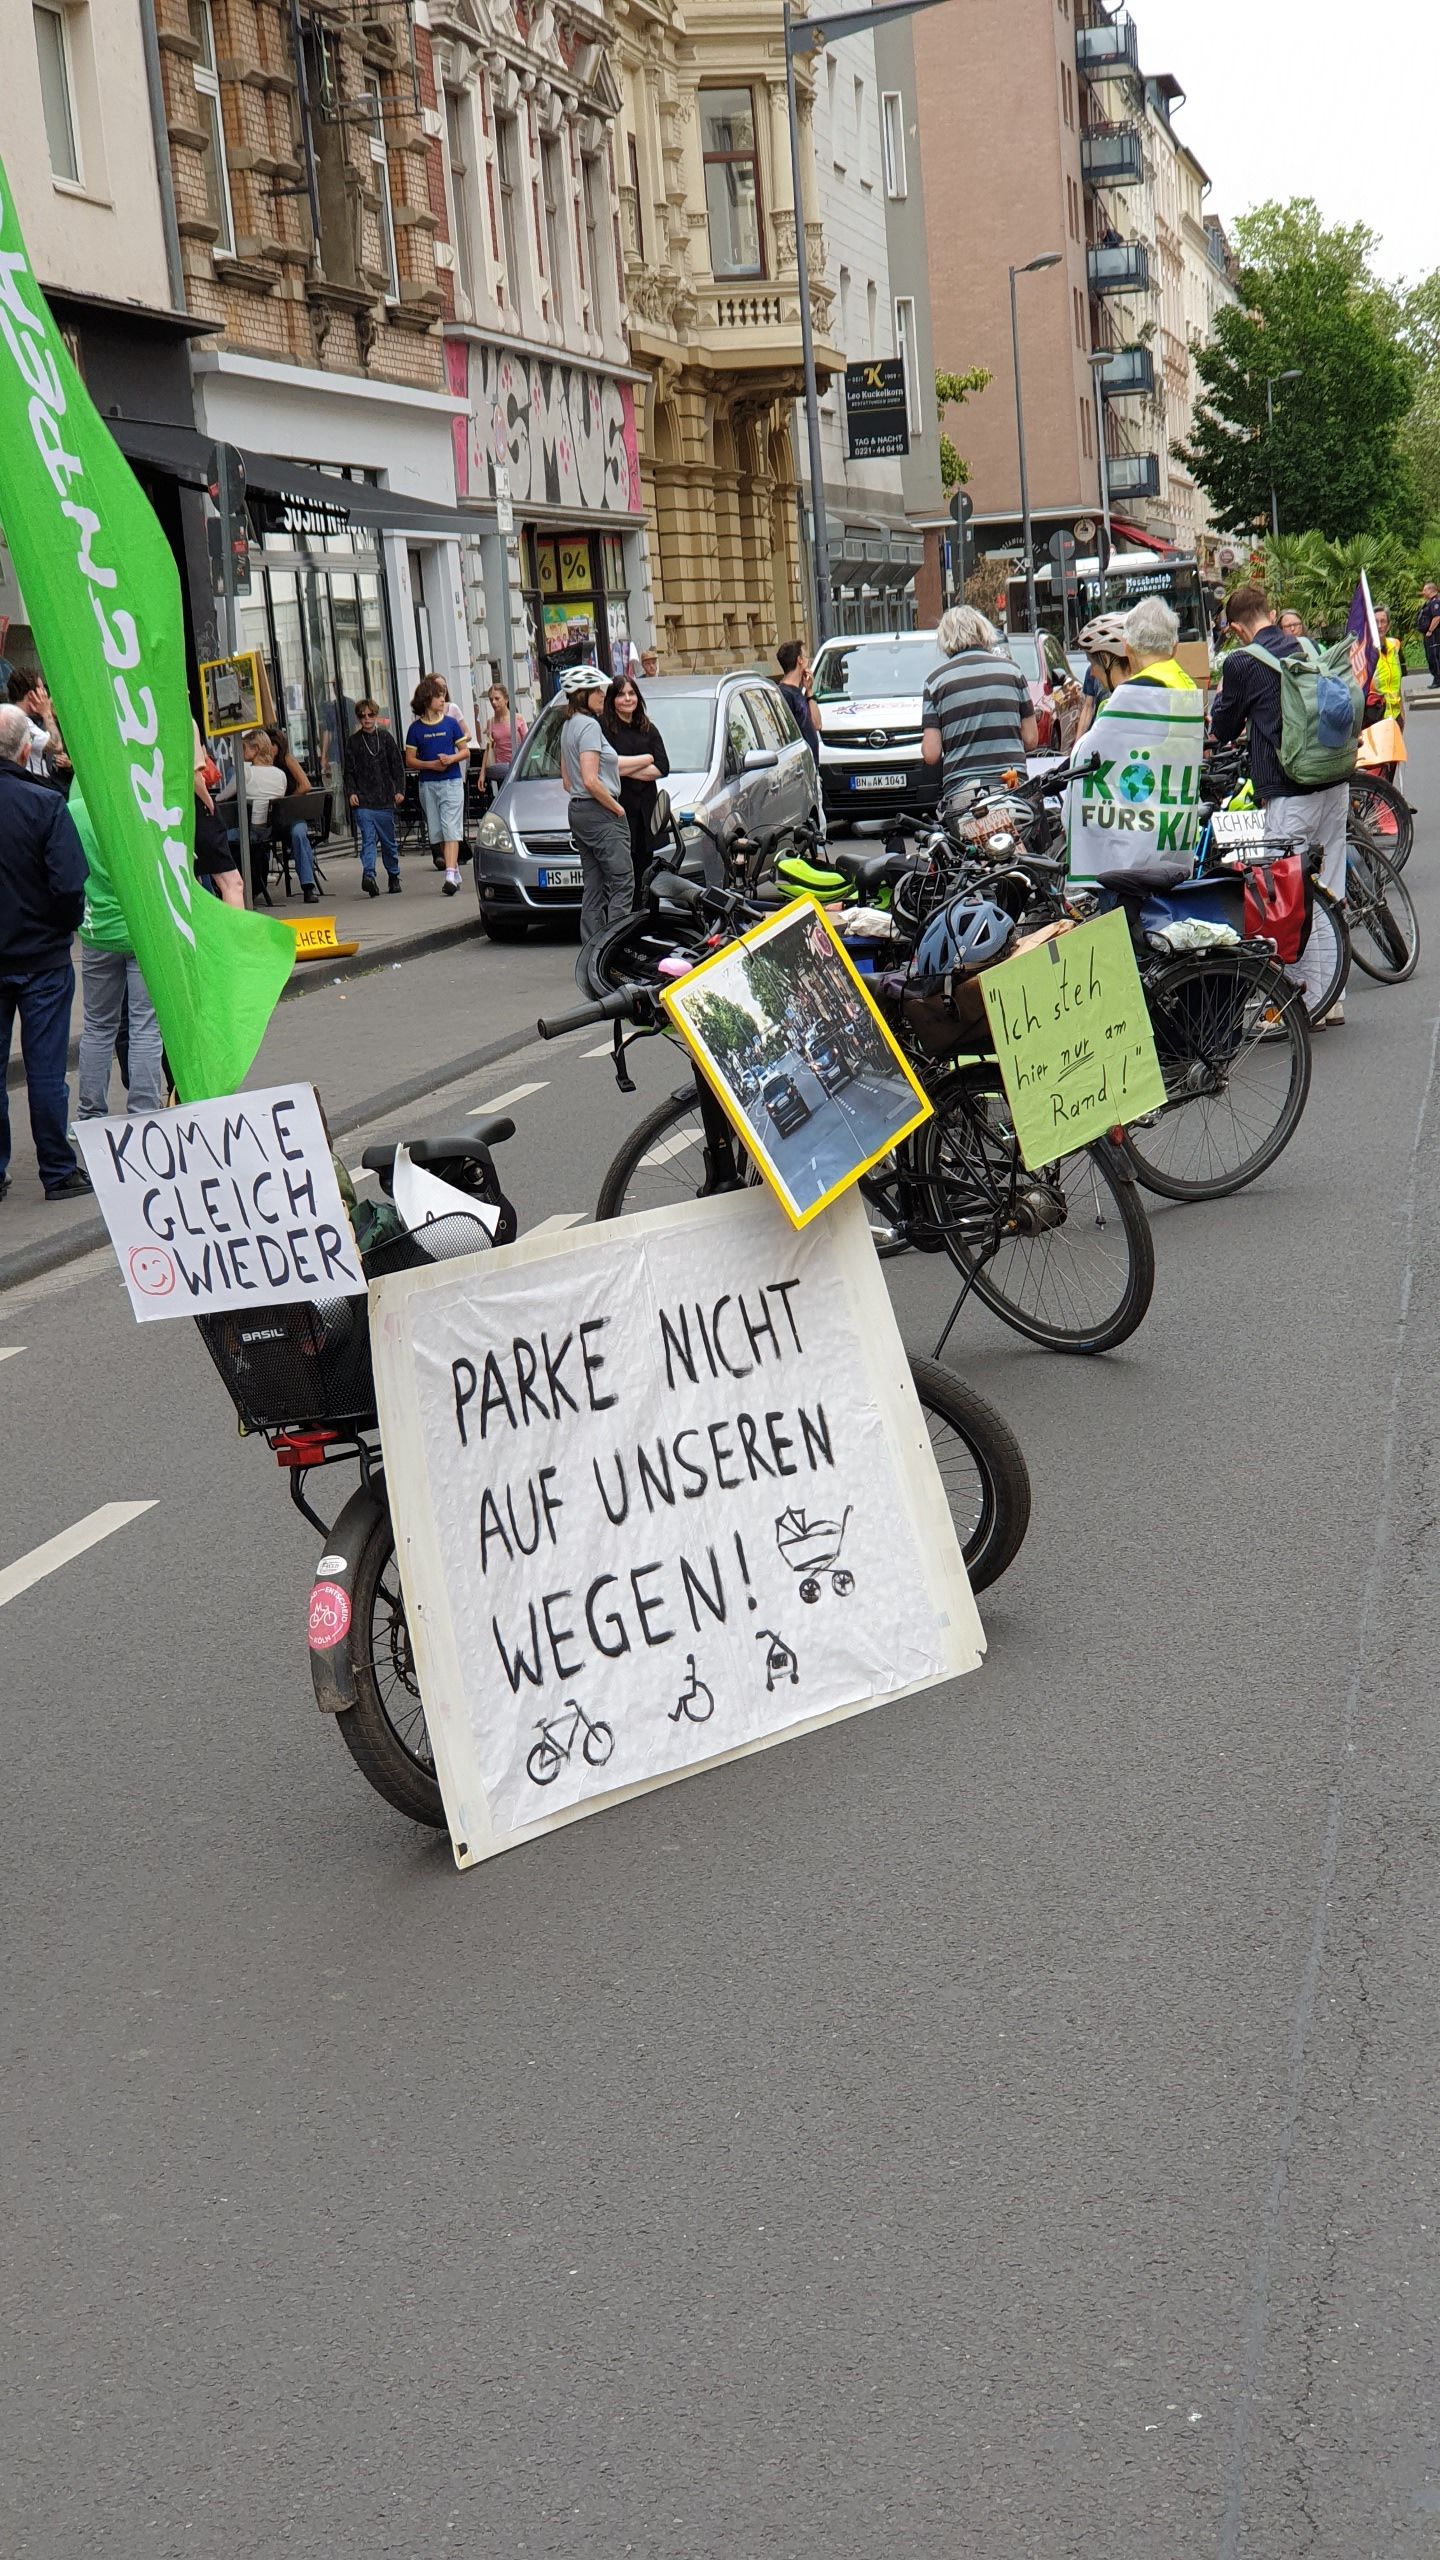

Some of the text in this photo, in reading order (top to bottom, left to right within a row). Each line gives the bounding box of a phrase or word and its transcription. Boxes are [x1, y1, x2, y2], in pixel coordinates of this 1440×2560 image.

[847, 388, 904, 400] Leo Kuckelkorn
[855, 435, 903, 446] TAG & NACHT
[855, 447, 872, 455] 0221
[0, 190, 196, 952] GREENPEA
[562, 551, 586, 579] %
[856, 775, 905, 787] BN AK 1041
[1081, 750, 1200, 805] KÖLL
[1081, 800, 1198, 852] FÜRS KL
[1215, 814, 1242, 832] ICH
[547, 871, 562, 885] HS
[1054, 946, 1101, 1021] steh
[1015, 1020, 1127, 1090] hier nur am
[105, 1100, 304, 1183] KOMME
[142, 1168, 317, 1242] GLEICH
[172, 1224, 358, 1296] WIEDER
[242, 1328, 285, 1342] BASIL
[452, 1278, 806, 1447] PARKE NICHT
[480, 1402, 836, 1575] AUF UNSEREN
[492, 1530, 759, 1694] WEGEN!
